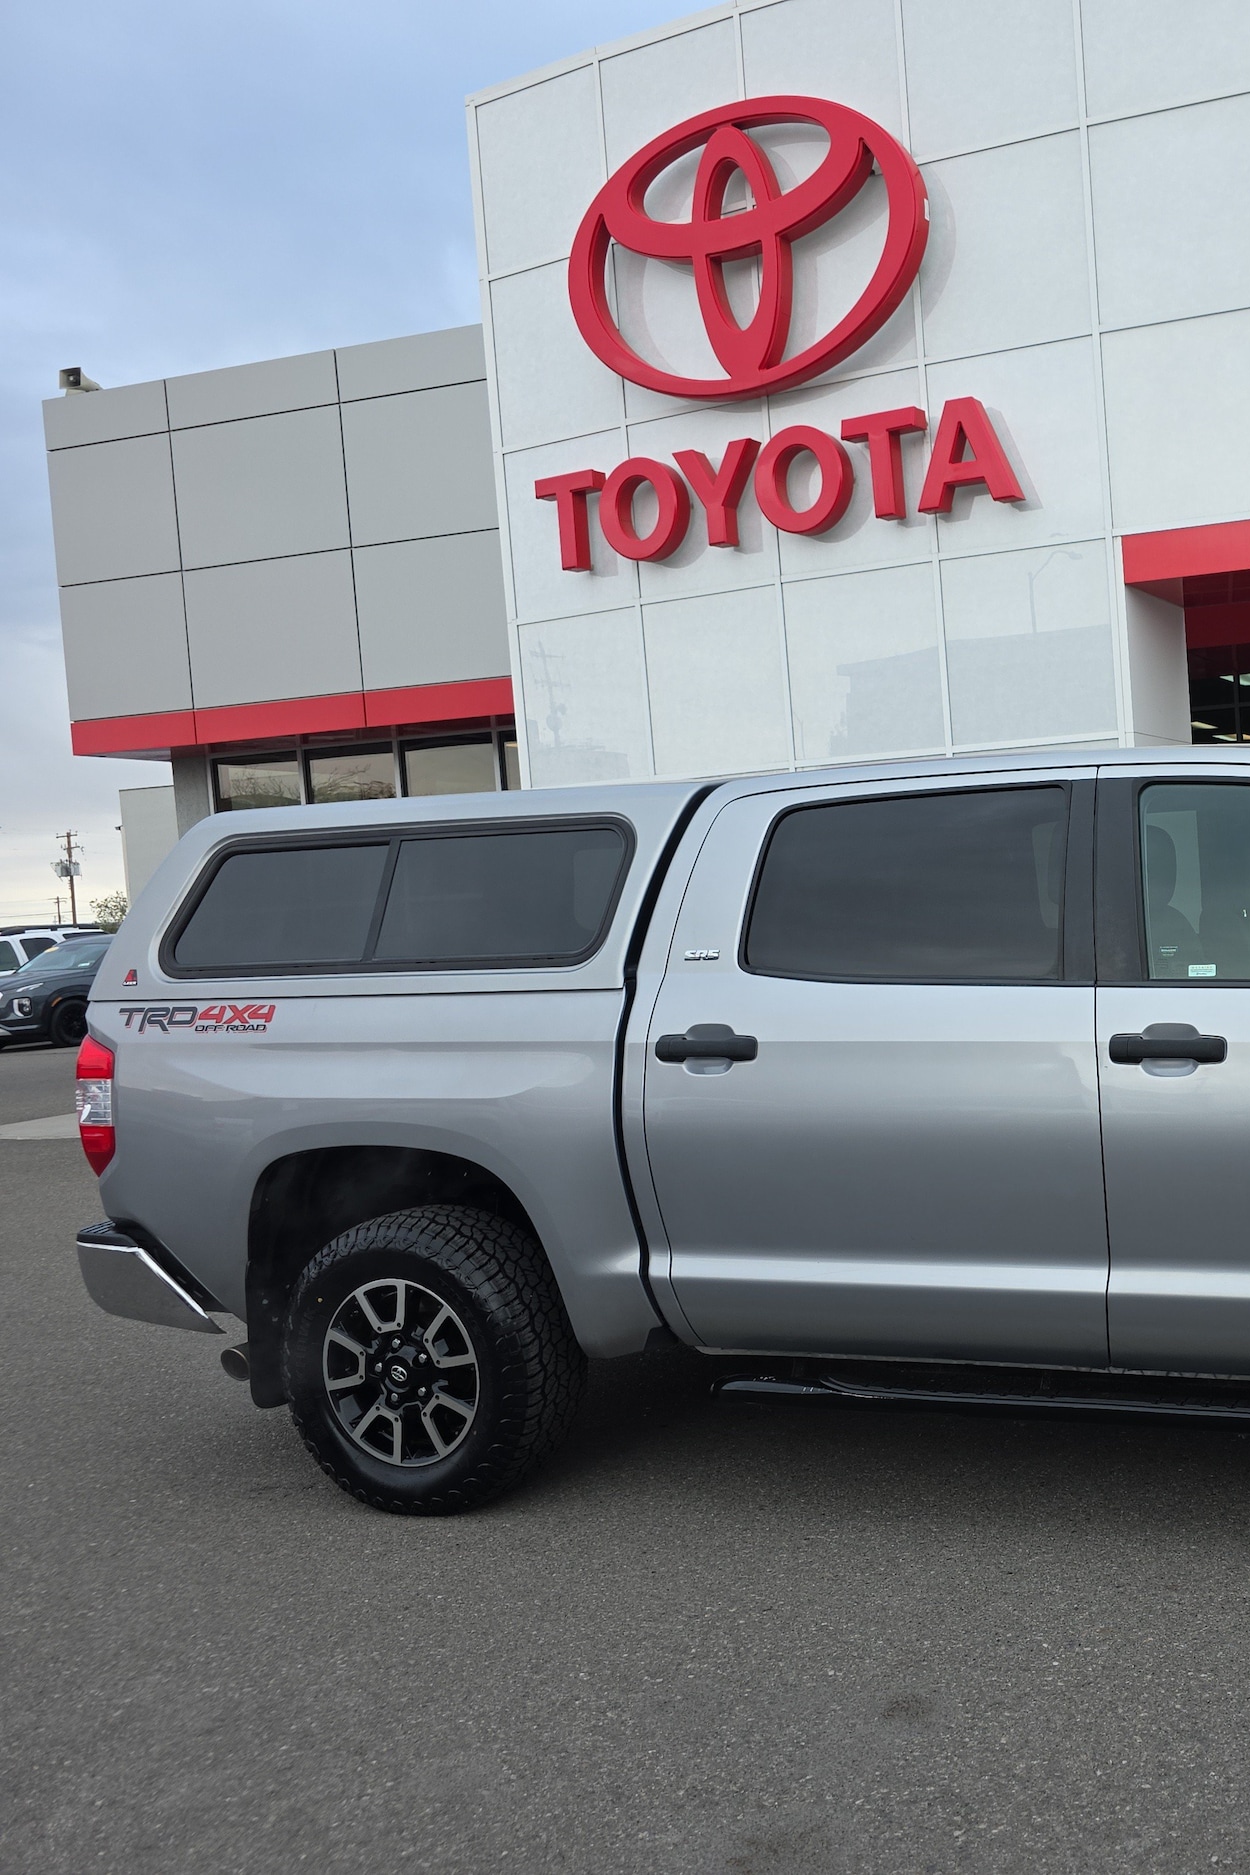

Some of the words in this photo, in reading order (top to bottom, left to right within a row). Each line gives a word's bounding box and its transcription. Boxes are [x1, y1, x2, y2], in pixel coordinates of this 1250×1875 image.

[535, 396, 1026, 572] TOYOTA
[684, 949, 720, 961] SR5
[118, 1006, 198, 1034] TRD
[198, 1004, 276, 1025] 4X4
[195, 1025, 225, 1033] OFF
[225, 1024, 267, 1033] ROAD
